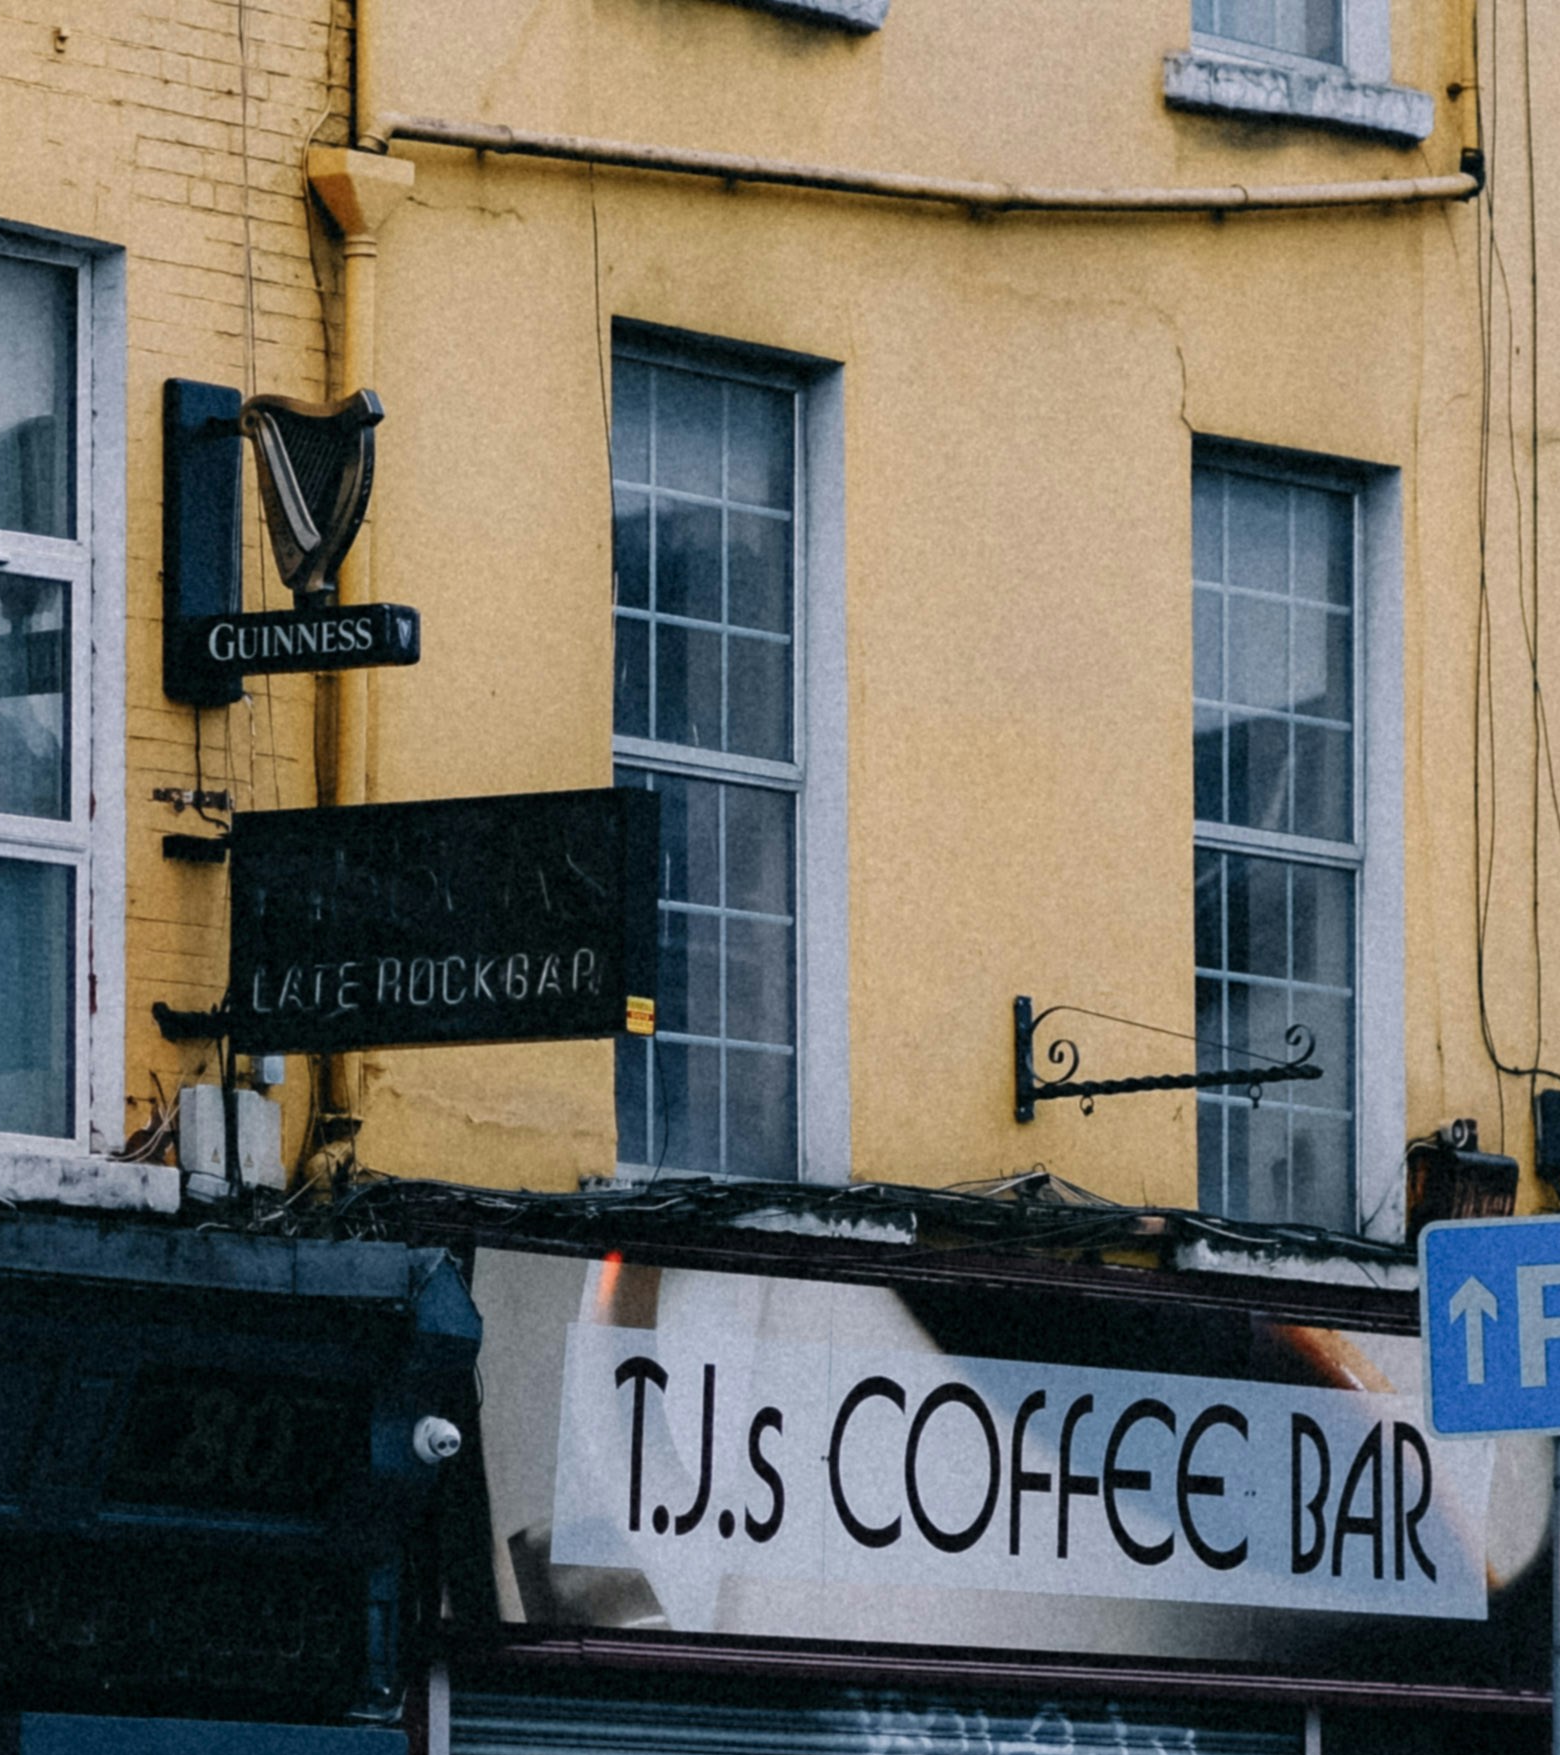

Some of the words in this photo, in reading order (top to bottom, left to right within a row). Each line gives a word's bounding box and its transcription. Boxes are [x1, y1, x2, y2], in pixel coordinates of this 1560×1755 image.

[208, 618, 373, 661] GUINNESS
[251, 960, 360, 1014] LATE
[377, 954, 494, 1006] ROCK
[504, 947, 601, 1001] BAR
[827, 1375, 1250, 1570] COFFEE
[1290, 1412, 1438, 1584] BAR
